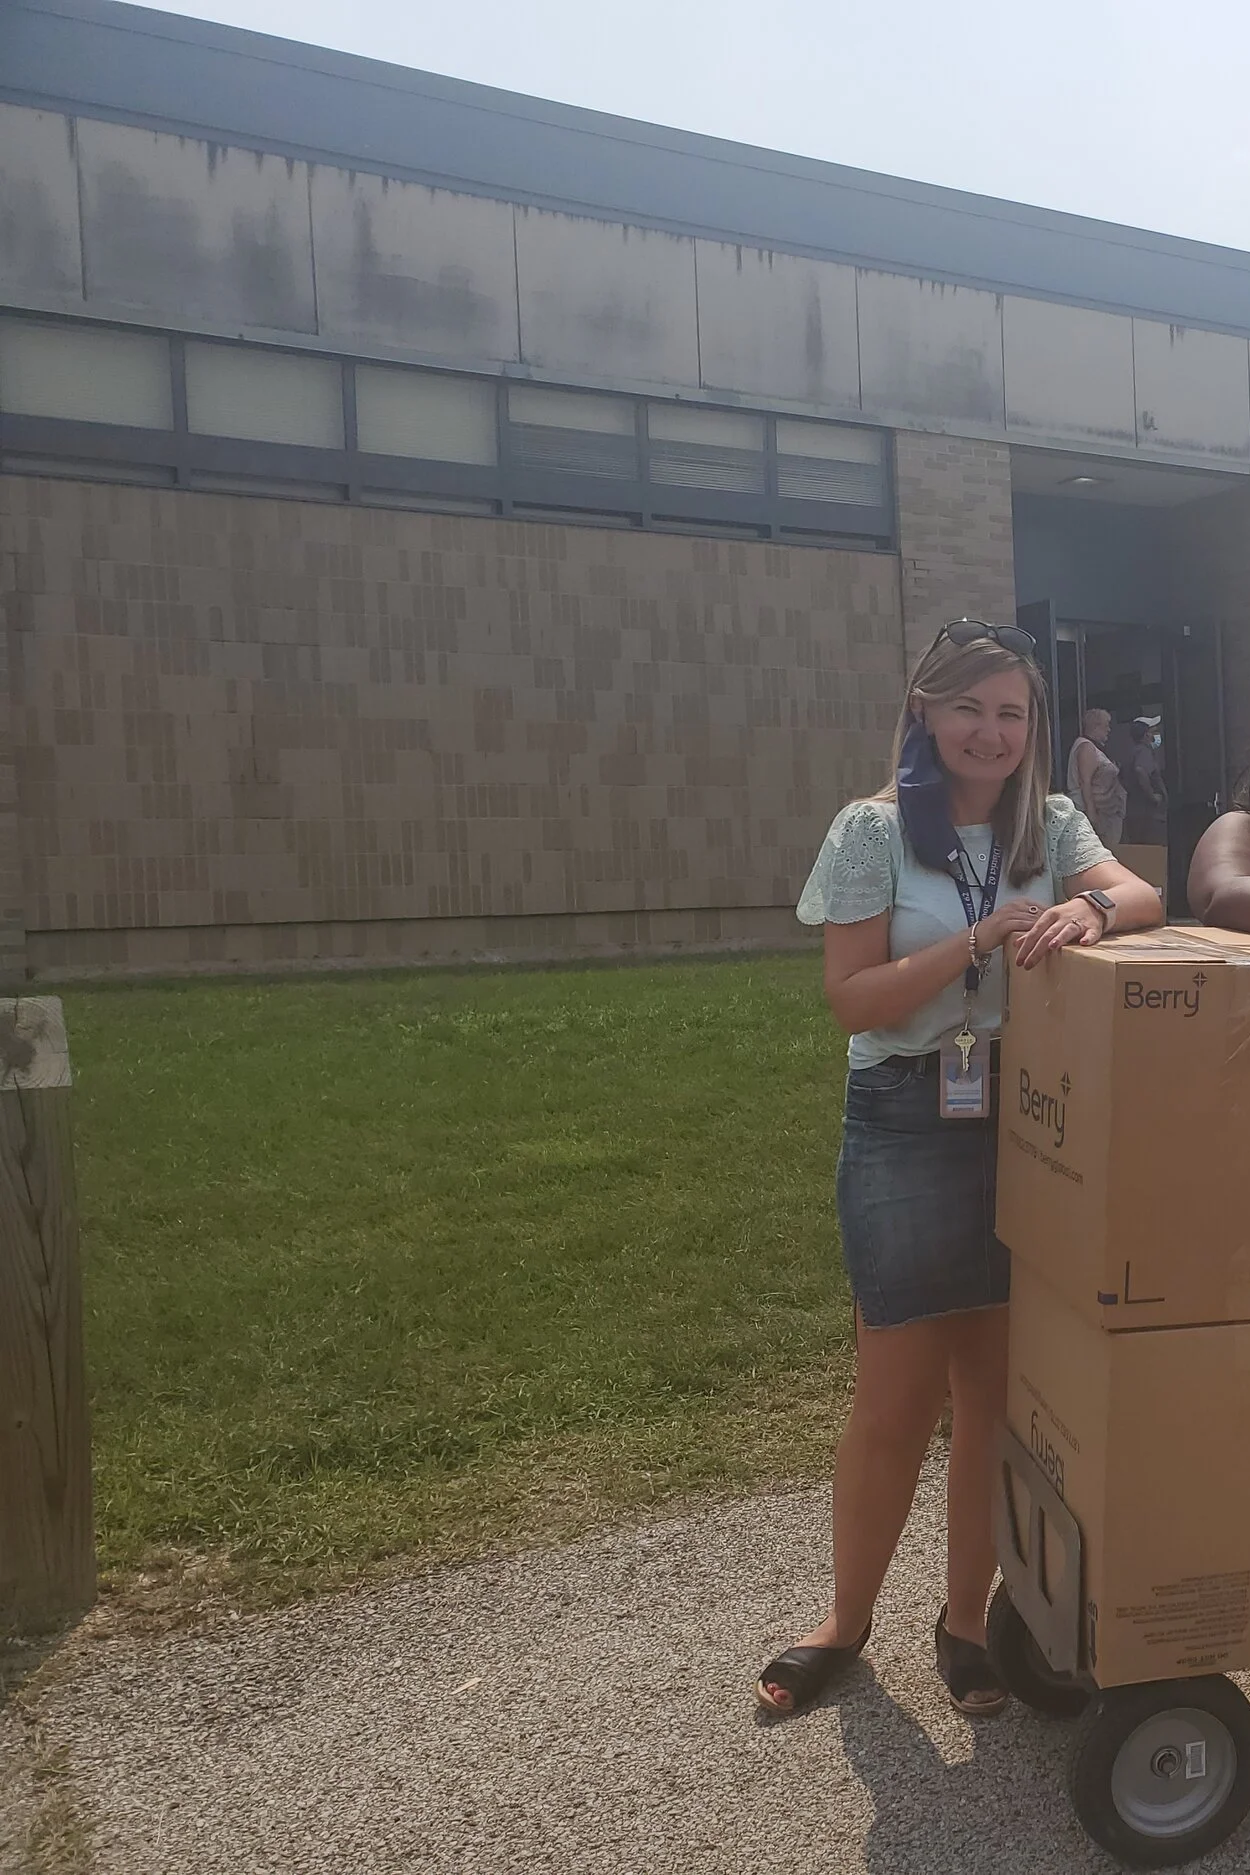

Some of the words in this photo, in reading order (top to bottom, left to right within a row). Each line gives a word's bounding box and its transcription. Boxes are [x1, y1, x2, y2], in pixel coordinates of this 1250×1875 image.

[990, 848, 1001, 875] District
[988, 876, 996, 886] 62
[1124, 981, 1200, 1018] Berry
[1020, 1068, 1065, 1148] Berry
[1031, 1410, 1065, 1501] Berry
